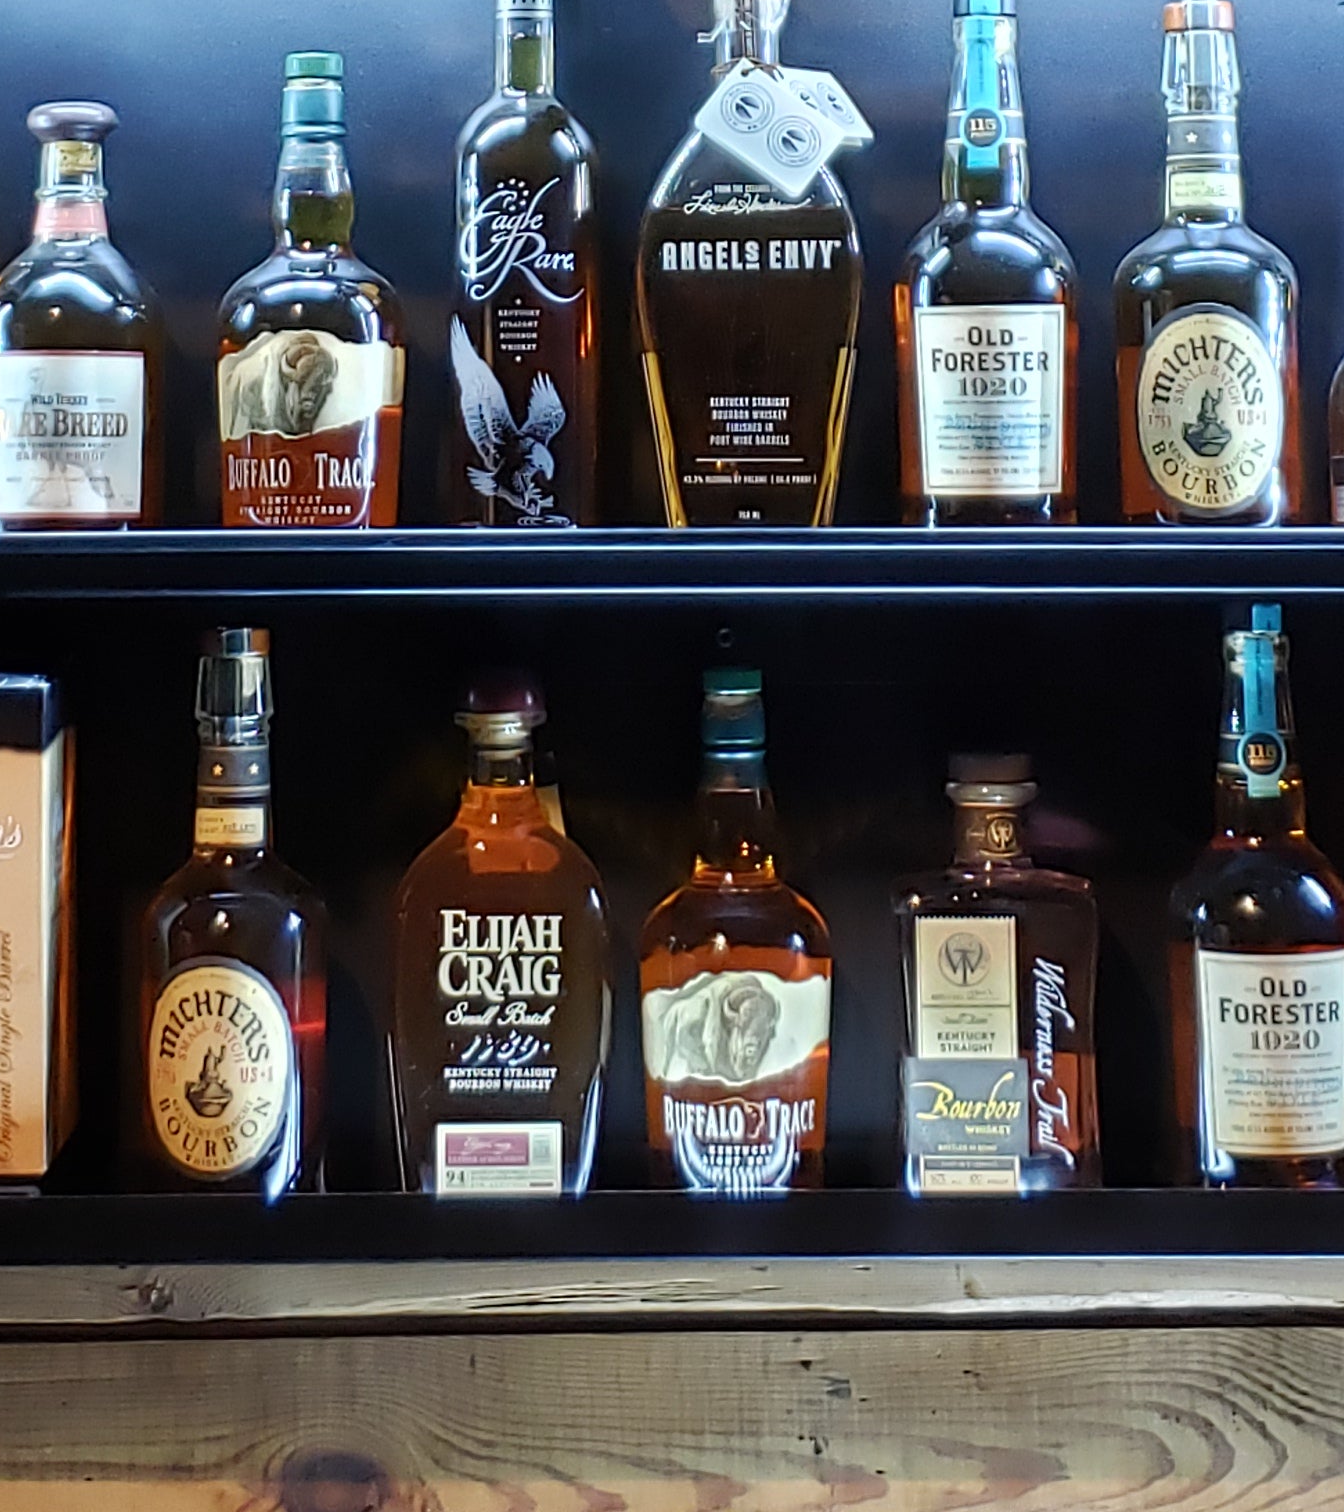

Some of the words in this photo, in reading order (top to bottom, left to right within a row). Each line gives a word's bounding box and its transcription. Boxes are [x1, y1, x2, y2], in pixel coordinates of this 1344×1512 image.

[459, 177, 560, 276] Eagle
[968, 326, 1013, 346] OLD
[931, 349, 1049, 372] FORESTER
[1152, 335, 1264, 406] MICHTER'S
[958, 377, 1027, 397] 1920
[1173, 365, 1207, 405] SMALL
[52, 409, 128, 438] BREED
[228, 454, 290, 490] BUFFALO
[1152, 438, 1266, 495] BOURBON
[439, 909, 563, 960] ELIJAH
[438, 951, 562, 1001] CRAIG
[1260, 977, 1307, 998] OLD
[160, 989, 270, 1064] MICHTER'S
[446, 1001, 499, 1026] Small
[497, 1001, 556, 1026] Batch
[1033, 957, 1076, 1079] Wilderness
[1219, 997, 1340, 1025] FORESTER
[937, 1031, 996, 1041] KENTUCKY
[940, 1043, 993, 1053] STRAIGHT
[1251, 1029, 1320, 1051] 1920
[444, 1067, 501, 1078] KENTUCKY
[503, 1067, 557, 1078] STRAIGHT
[449, 1078, 501, 1091] BOURBON
[503, 1078, 552, 1090] WHISKEY
[910, 1071, 1022, 1120] Bourbon
[159, 1096, 271, 1157] BOURBON
[663, 1095, 745, 1138] BUFFALO
[765, 1098, 816, 1138] TRACE
[1032, 1078, 1076, 1170] Trail
